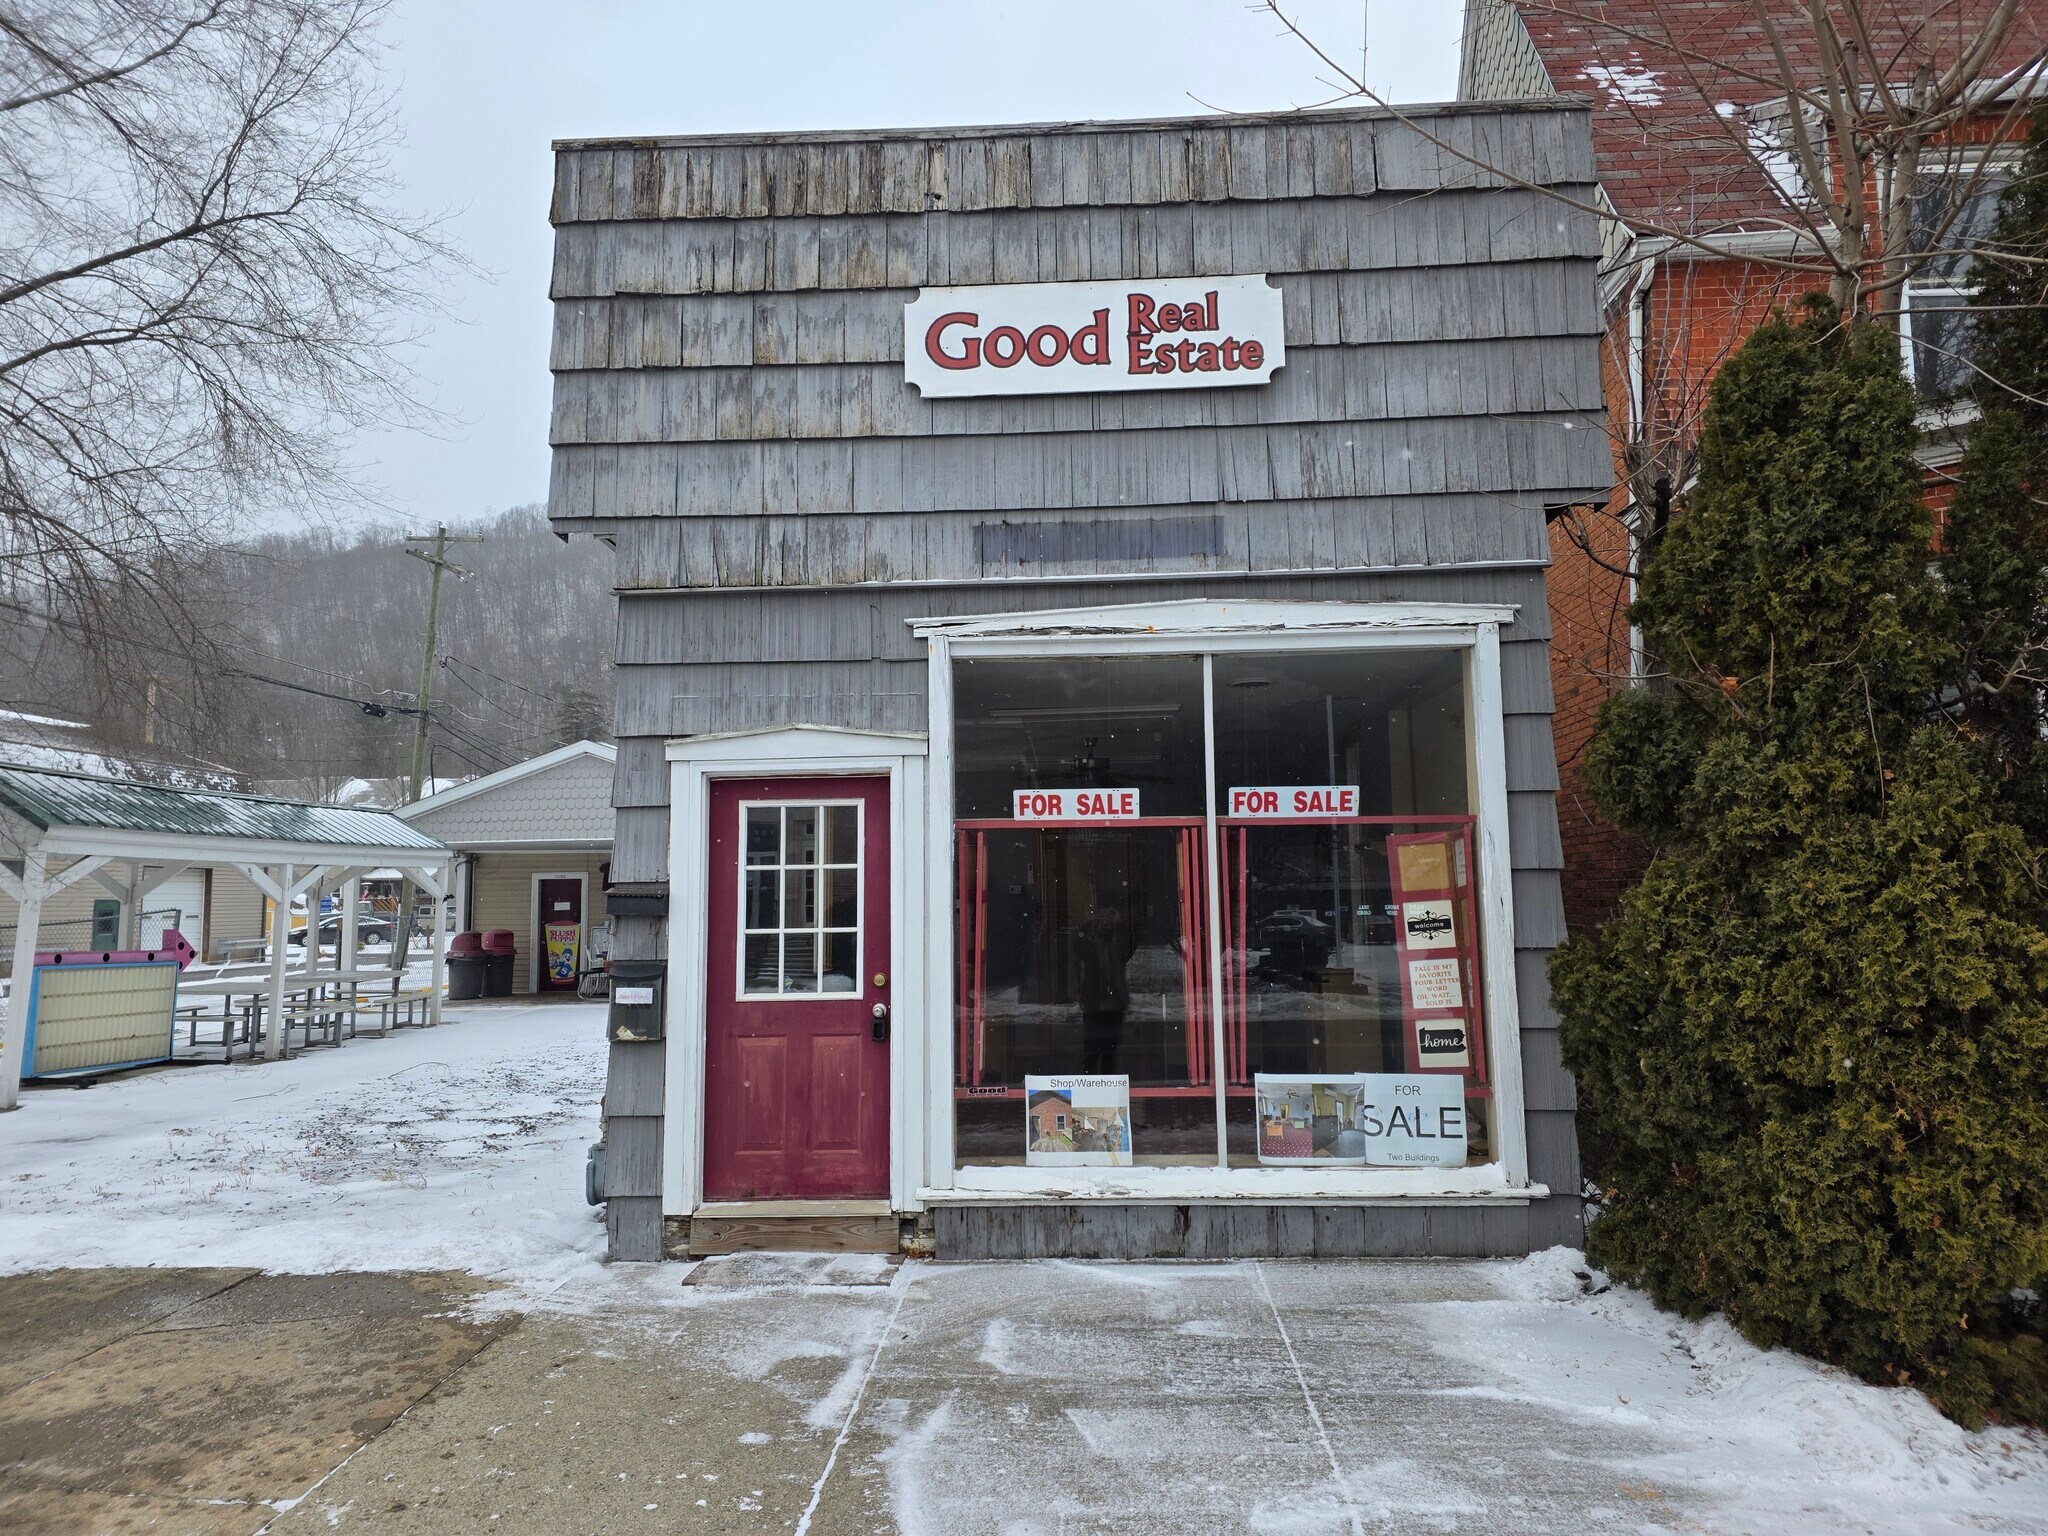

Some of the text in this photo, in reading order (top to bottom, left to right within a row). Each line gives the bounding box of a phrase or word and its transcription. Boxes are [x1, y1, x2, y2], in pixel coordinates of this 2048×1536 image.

[1127, 291, 1220, 334] Real
[925, 308, 1111, 370] Good
[1127, 333, 1265, 375] Estate
[1018, 793, 1134, 816] FOR SALE
[1233, 790, 1353, 813] FOR SALE
[549, 929, 576, 937] SLUSH
[1420, 1033, 1462, 1048] home
[968, 1086, 1006, 1094] Good
[1050, 1078, 1127, 1089] Shop/Warehouse
[1395, 1085, 1421, 1096] FOR
[1363, 1104, 1463, 1139] SALE
[1387, 1153, 1440, 1163] Two Buildings
